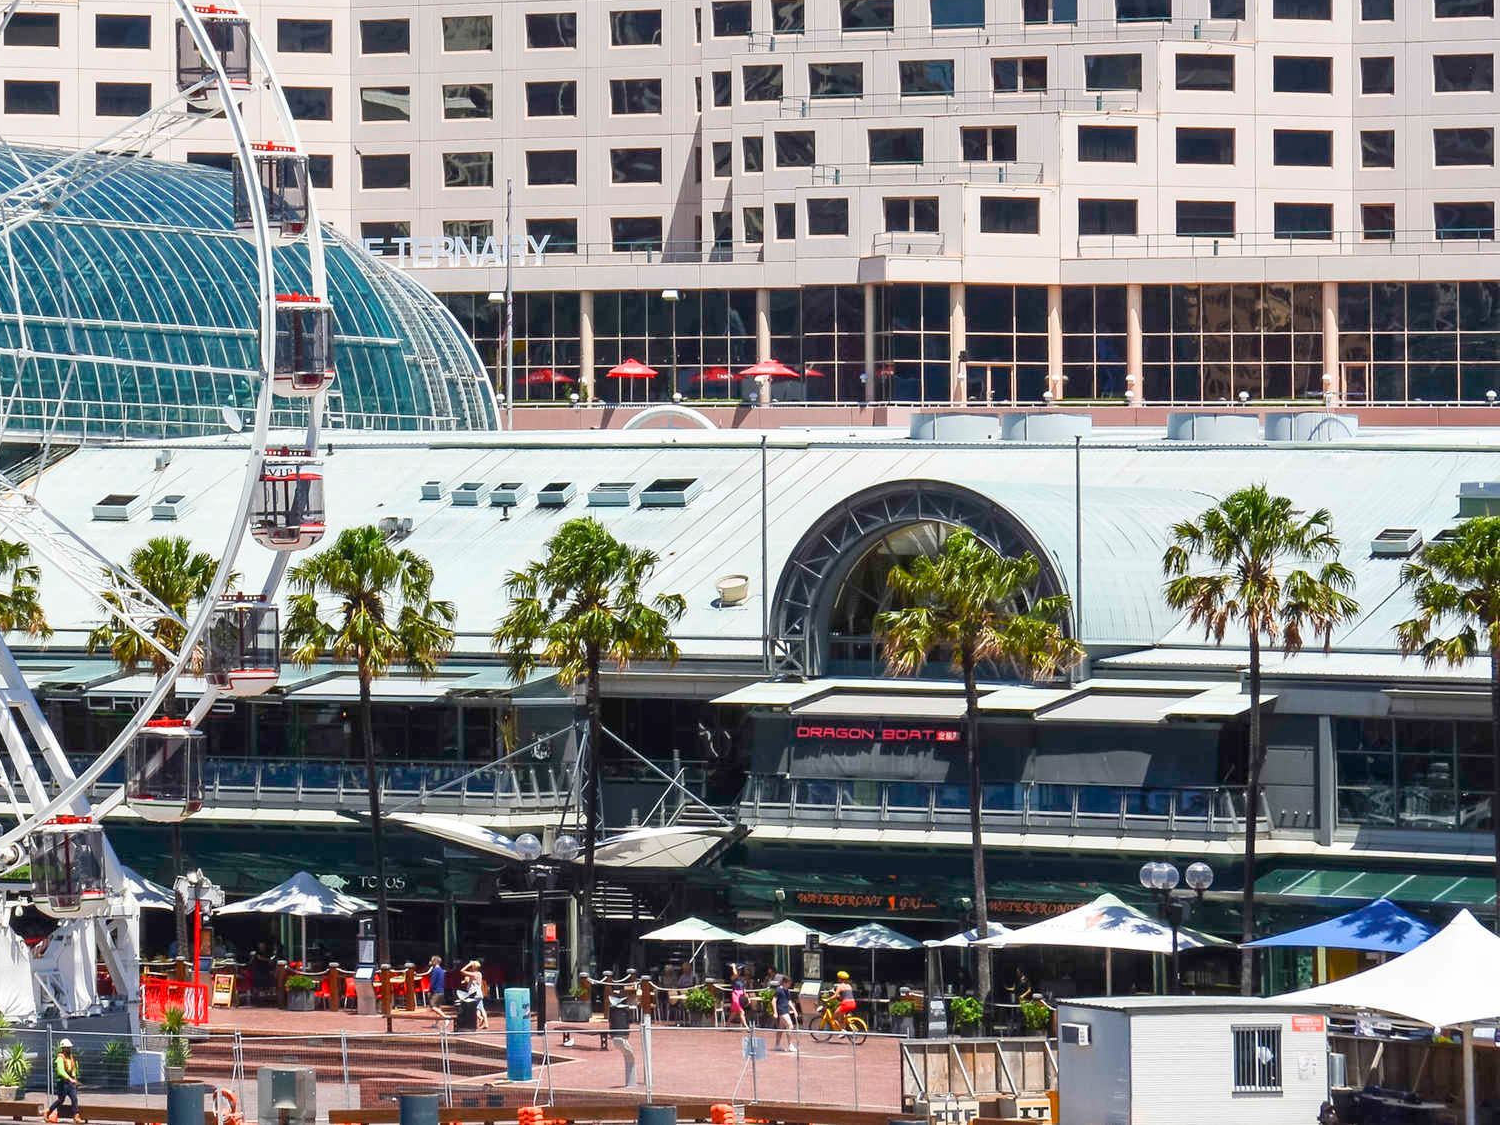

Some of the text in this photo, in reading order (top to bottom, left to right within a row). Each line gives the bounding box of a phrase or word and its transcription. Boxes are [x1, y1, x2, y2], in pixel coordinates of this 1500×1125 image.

[269, 469, 293, 477] VIP
[796, 727, 876, 740] DRAGON
[882, 729, 935, 741] BOAT
